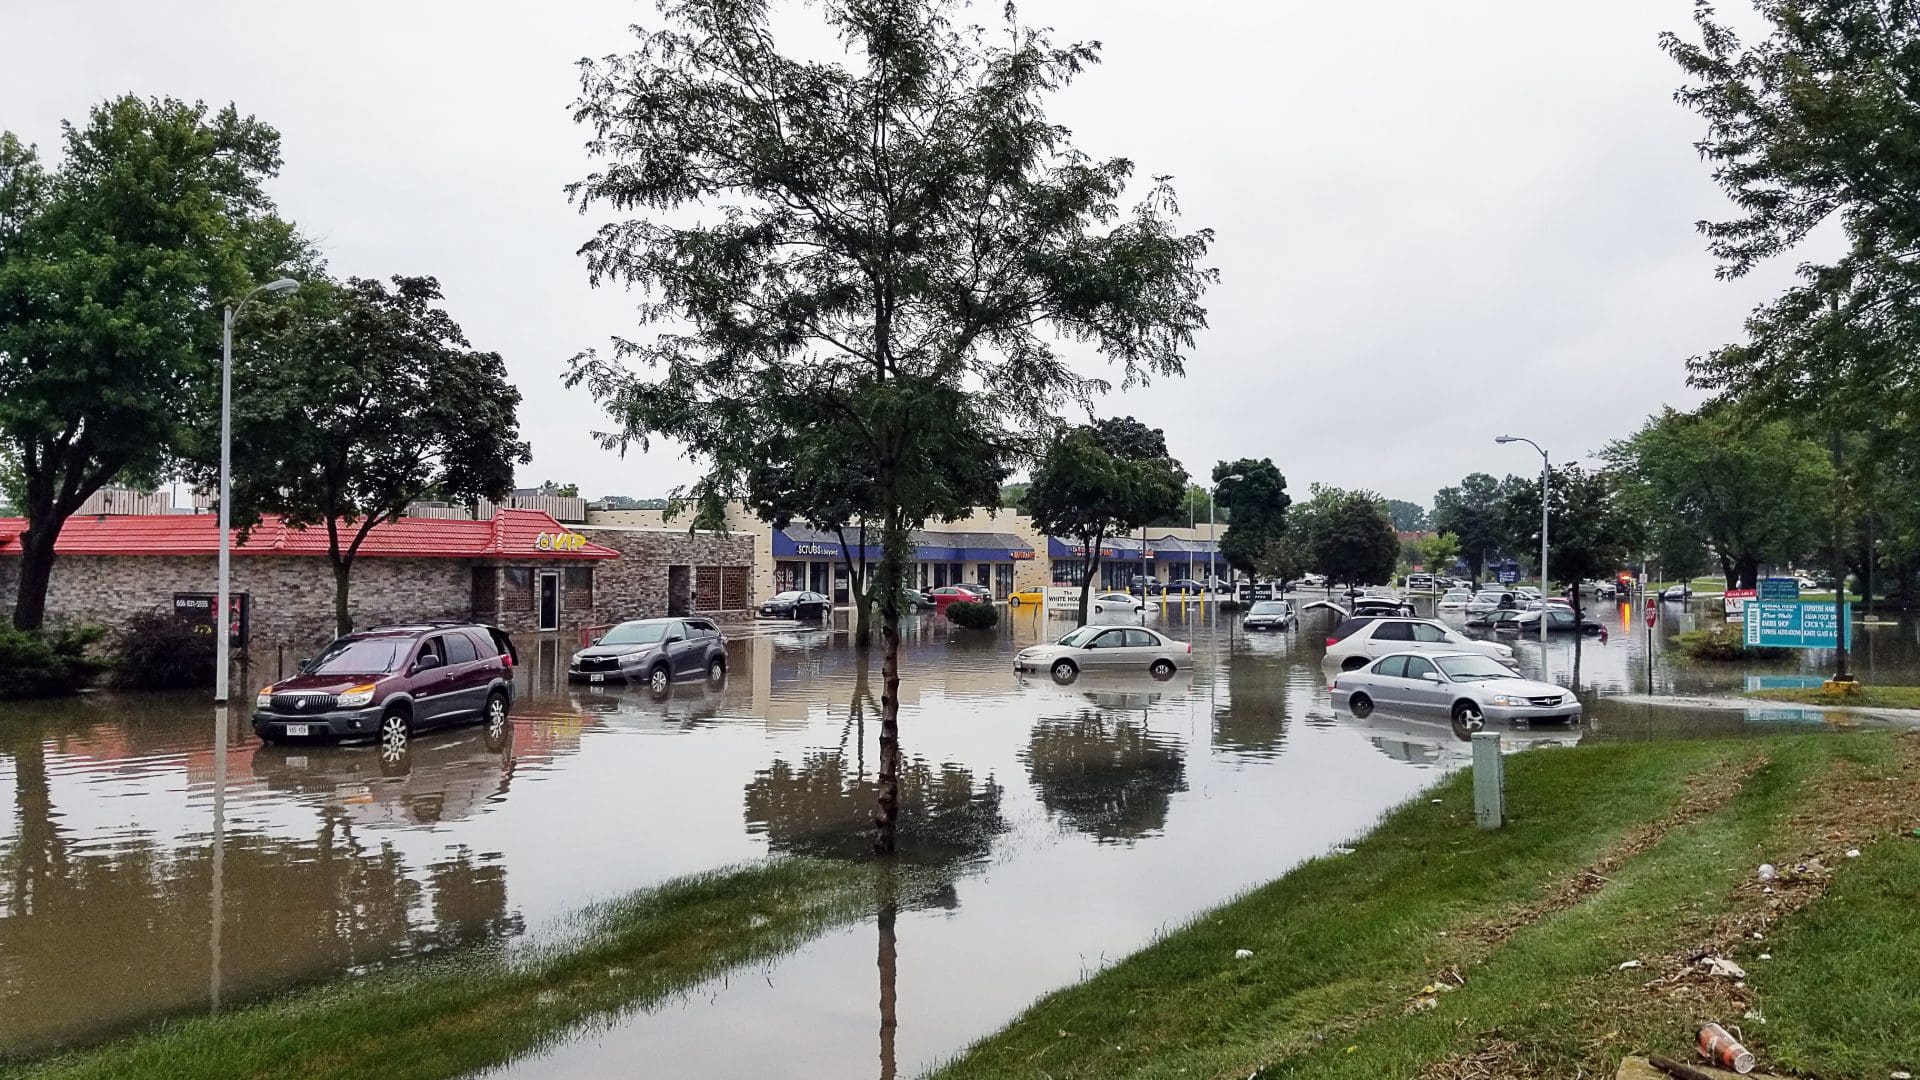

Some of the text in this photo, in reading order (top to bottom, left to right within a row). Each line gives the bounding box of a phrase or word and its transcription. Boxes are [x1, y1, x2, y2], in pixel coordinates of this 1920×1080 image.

[551, 532, 586, 551] VIP
[798, 544, 821, 554] scrubs
[1646, 607, 1656, 619] STOP
